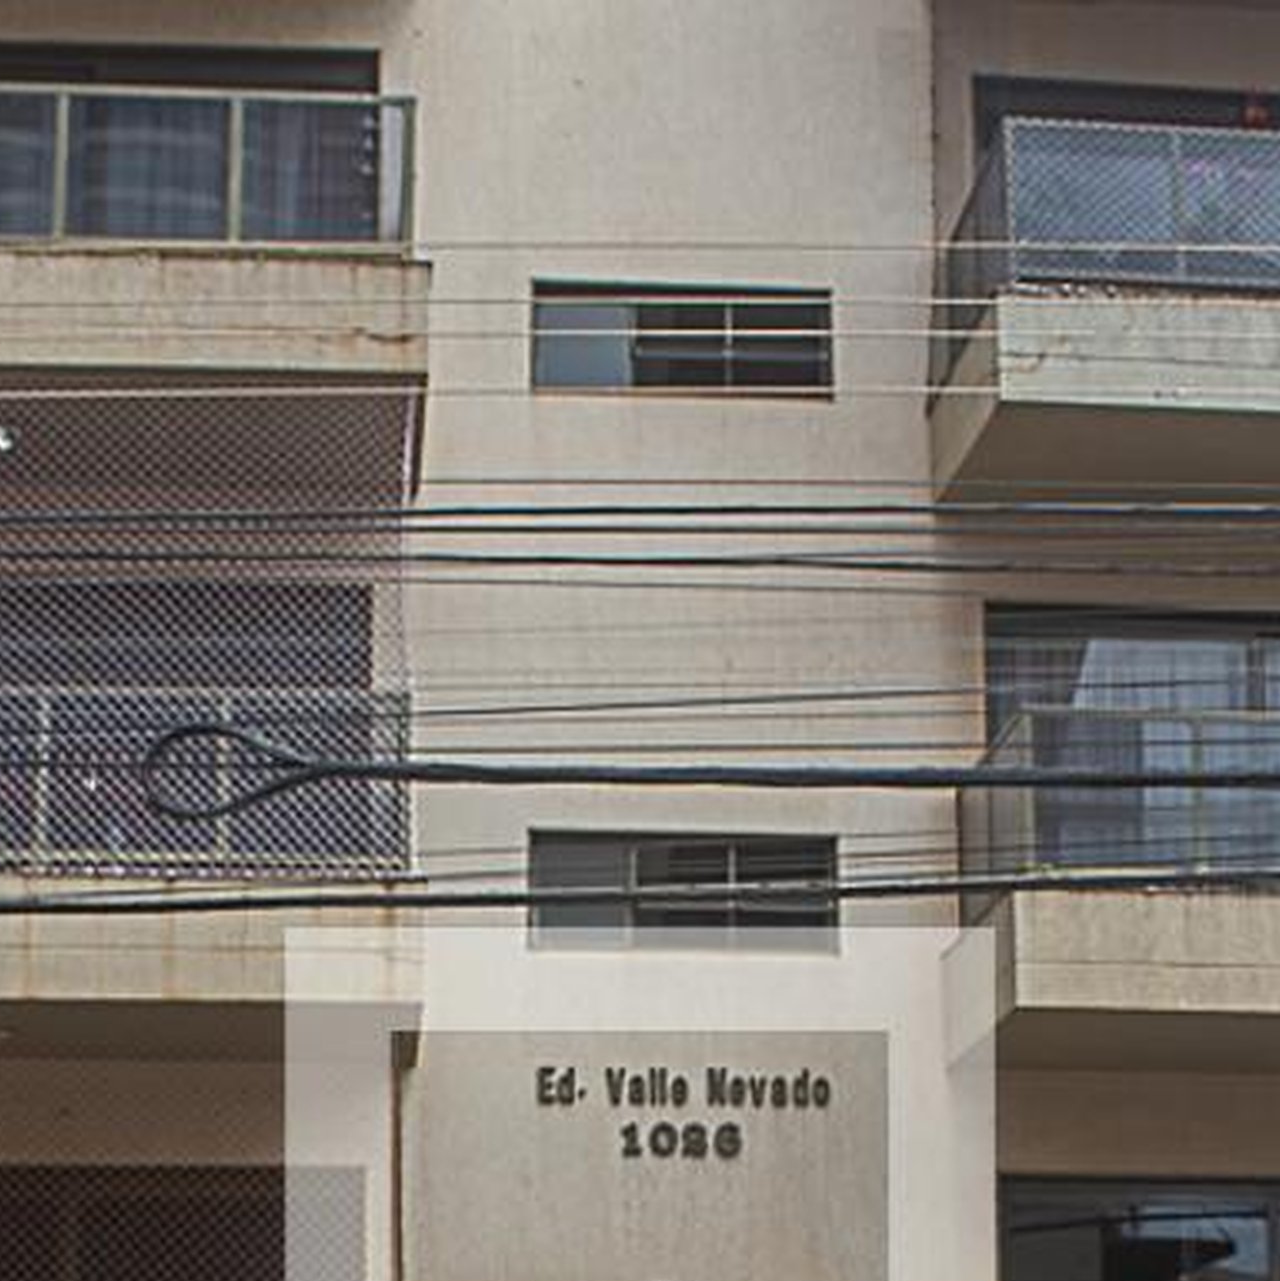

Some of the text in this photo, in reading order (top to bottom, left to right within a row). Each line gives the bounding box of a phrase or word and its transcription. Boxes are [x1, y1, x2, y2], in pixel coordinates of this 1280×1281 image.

[536, 1066, 831, 1108] Ed. Valle Nevado
[620, 1121, 742, 1158] 1026
